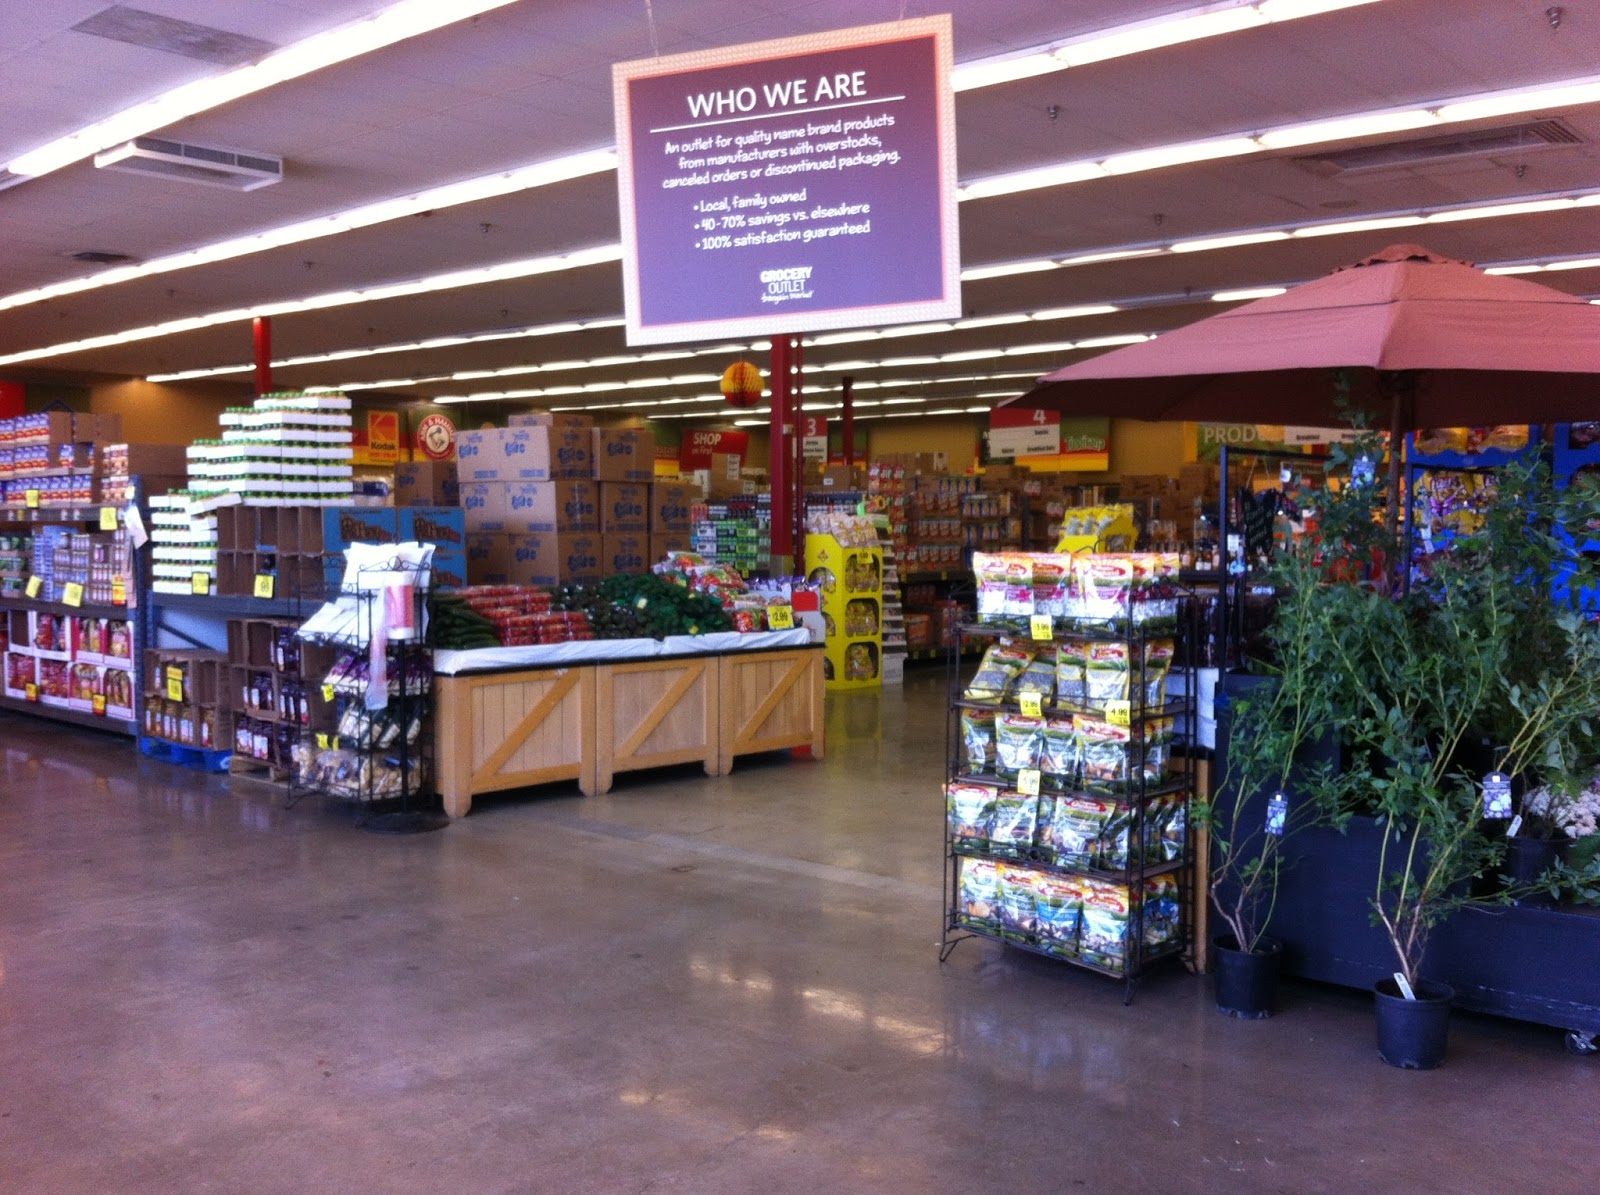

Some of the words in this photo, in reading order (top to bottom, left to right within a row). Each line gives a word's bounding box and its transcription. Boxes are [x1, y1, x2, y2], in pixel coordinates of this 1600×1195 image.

[687, 87, 757, 118] WHO
[763, 79, 808, 108] WE
[814, 71, 867, 102] ARE
[665, 142, 680, 155] An
[681, 137, 713, 153] outlet
[715, 135, 733, 148] for
[734, 130, 771, 148] quality
[773, 128, 806, 141] name
[807, 119, 842, 136] brand
[843, 113, 896, 135] products
[679, 157, 706, 170] from
[706, 147, 788, 167] manufacturers
[789, 141, 814, 155] with
[815, 133, 882, 152] overstocks,
[662, 172, 710, 189] canceled
[711, 169, 748, 183] orders
[749, 168, 763, 179] or
[764, 155, 837, 177] discontinued
[838, 149, 901, 170] packaging.
[700, 197, 731, 212] Local,
[731, 193, 768, 209] family
[769, 188, 807, 204] owned
[748, 211, 791, 227] savings
[792, 210, 809, 221] vs.
[810, 202, 871, 220] elsewhere
[702, 235, 732, 250] 100%
[733, 229, 801, 247] satisfaction
[803, 219, 871, 243] guaranteed
[760, 266, 813, 283] GROCERY
[768, 279, 806, 294] OUTLET
[807, 418, 816, 436] 3
[1033, 409, 1047, 425] 4
[371, 441, 396, 451] Kodak
[693, 432, 722, 446] SHOP
